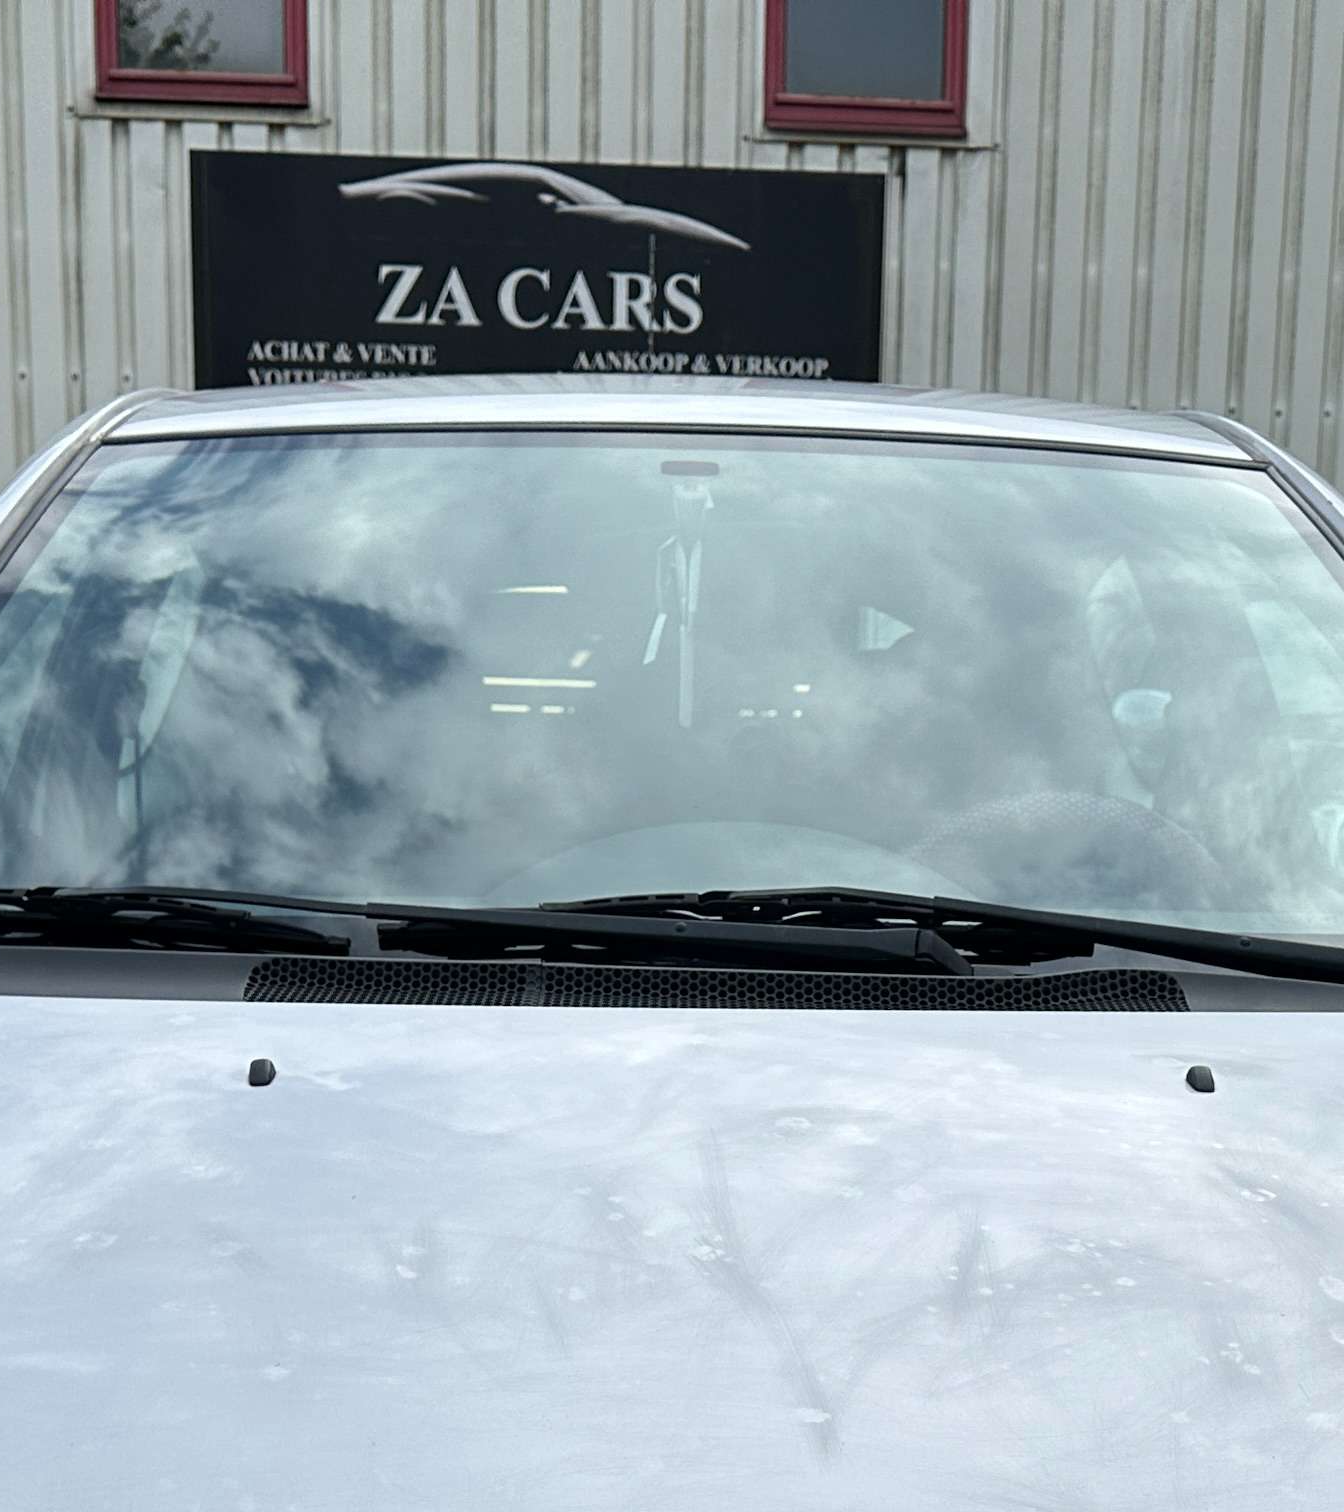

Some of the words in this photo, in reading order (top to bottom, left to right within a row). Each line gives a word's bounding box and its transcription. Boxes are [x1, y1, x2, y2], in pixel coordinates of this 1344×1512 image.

[375, 264, 483, 326] ZA
[497, 267, 703, 334] CARS
[247, 340, 330, 362] ACHAT
[332, 342, 354, 363] &
[357, 343, 437, 366] VENTE
[573, 351, 689, 374] AANKOOP
[690, 354, 711, 374] &
[715, 354, 830, 378] VERKOOP
